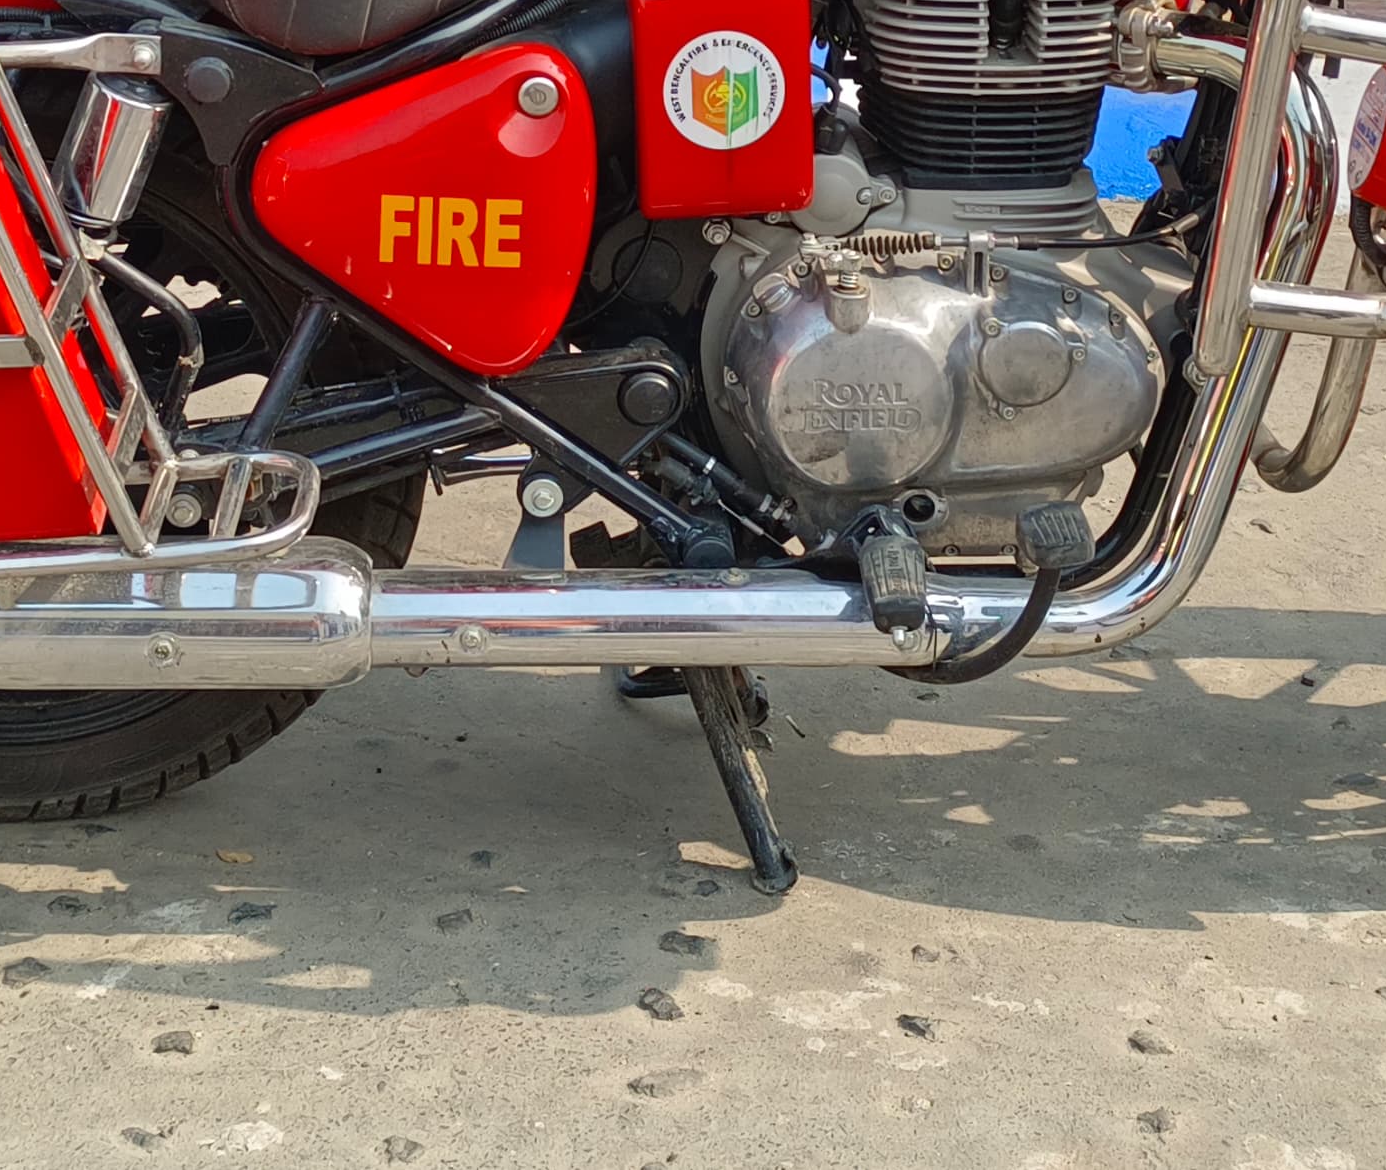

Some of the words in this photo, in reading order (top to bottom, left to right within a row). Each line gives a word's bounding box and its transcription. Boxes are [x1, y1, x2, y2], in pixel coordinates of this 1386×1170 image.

[688, 41, 709, 60] FIRE
[670, 57, 690, 95] BENGAL
[670, 96, 686, 123] WEST
[379, 194, 523, 268] FIRE
[812, 378, 910, 408] ROYAL
[801, 406, 922, 434] ENFIELD
